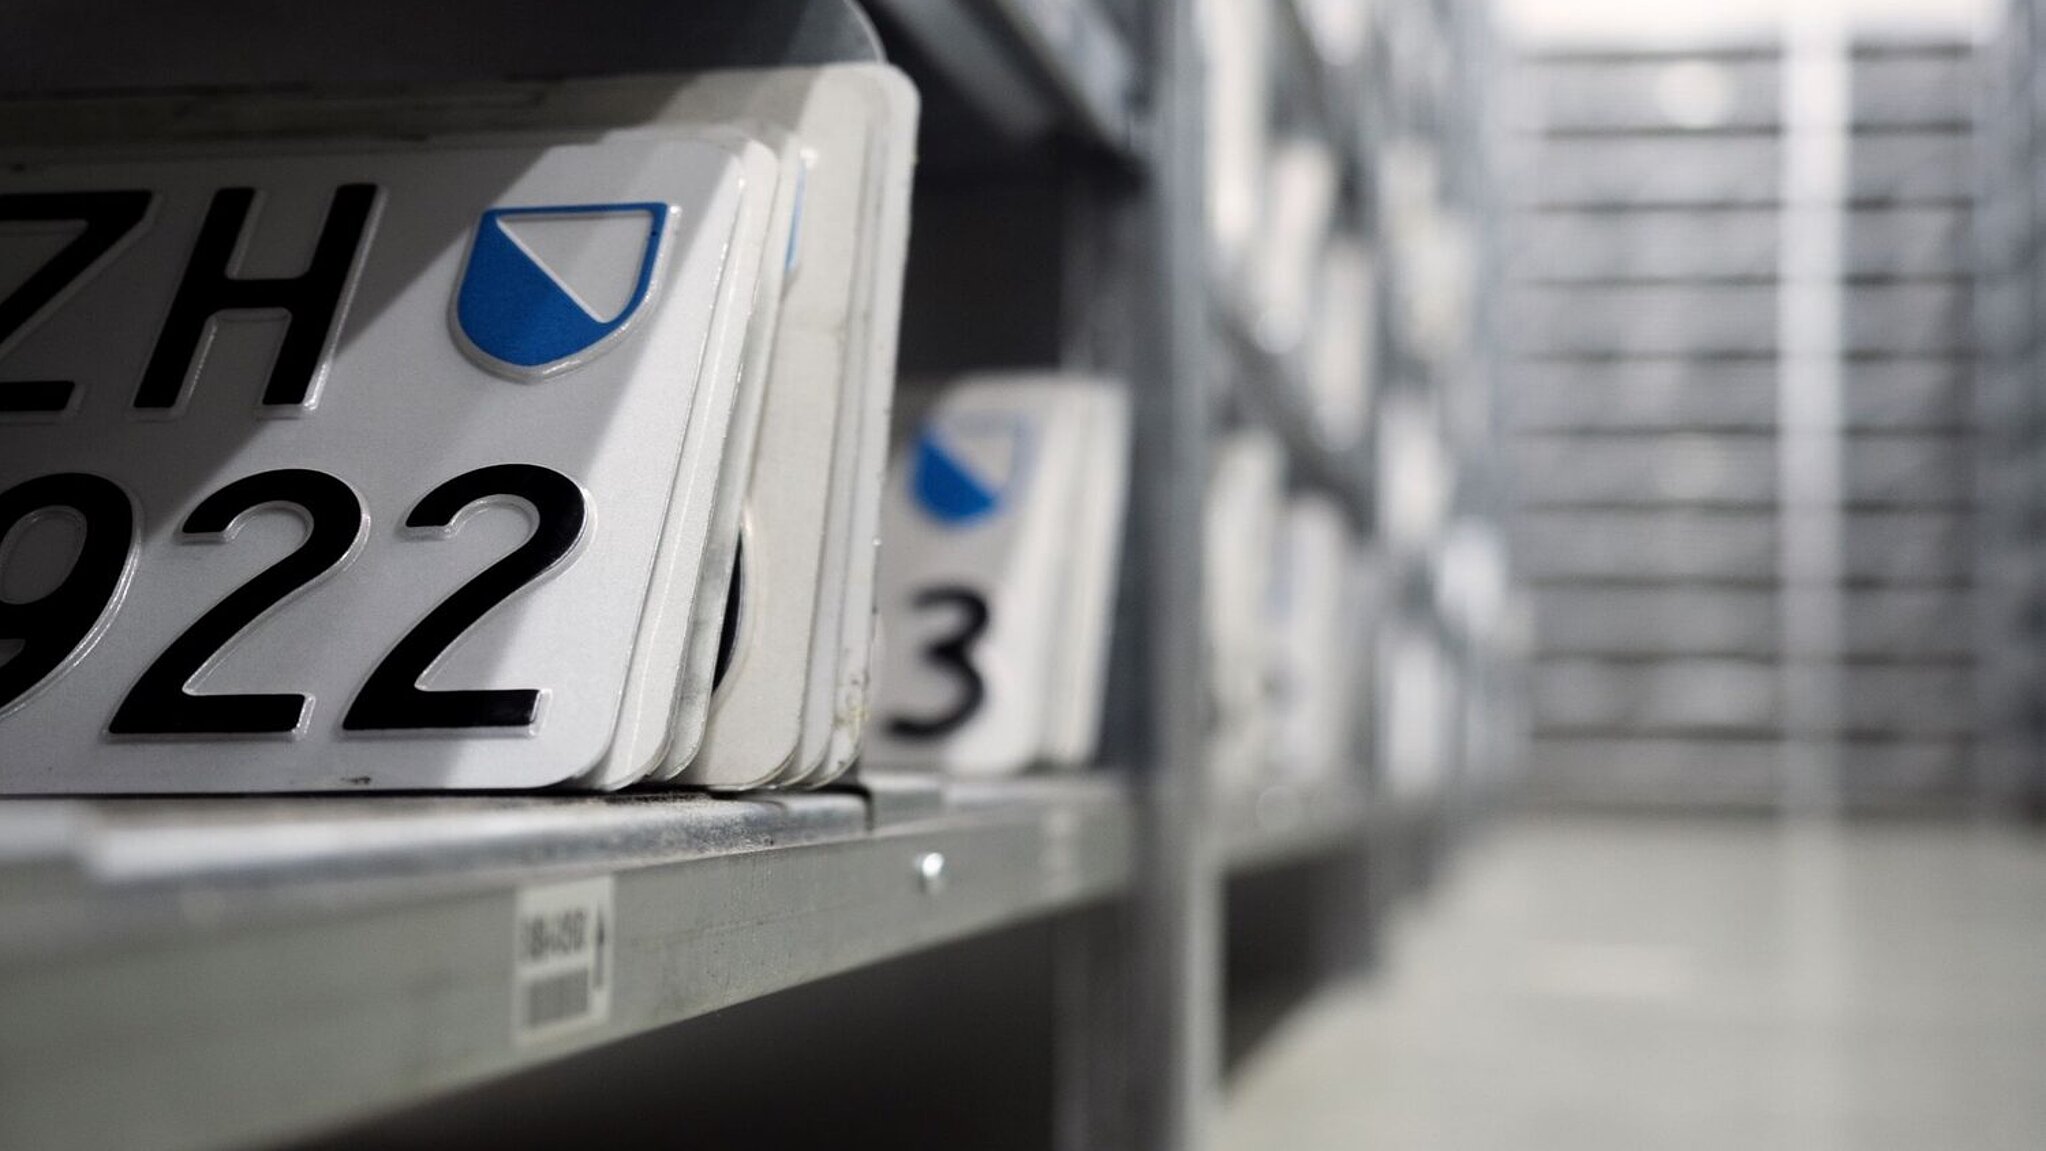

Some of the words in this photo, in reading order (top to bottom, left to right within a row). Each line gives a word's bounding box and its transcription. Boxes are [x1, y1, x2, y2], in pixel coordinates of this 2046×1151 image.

[0, 183, 380, 411] ZH
[0, 463, 588, 735] 922
[882, 583, 991, 741] 3
